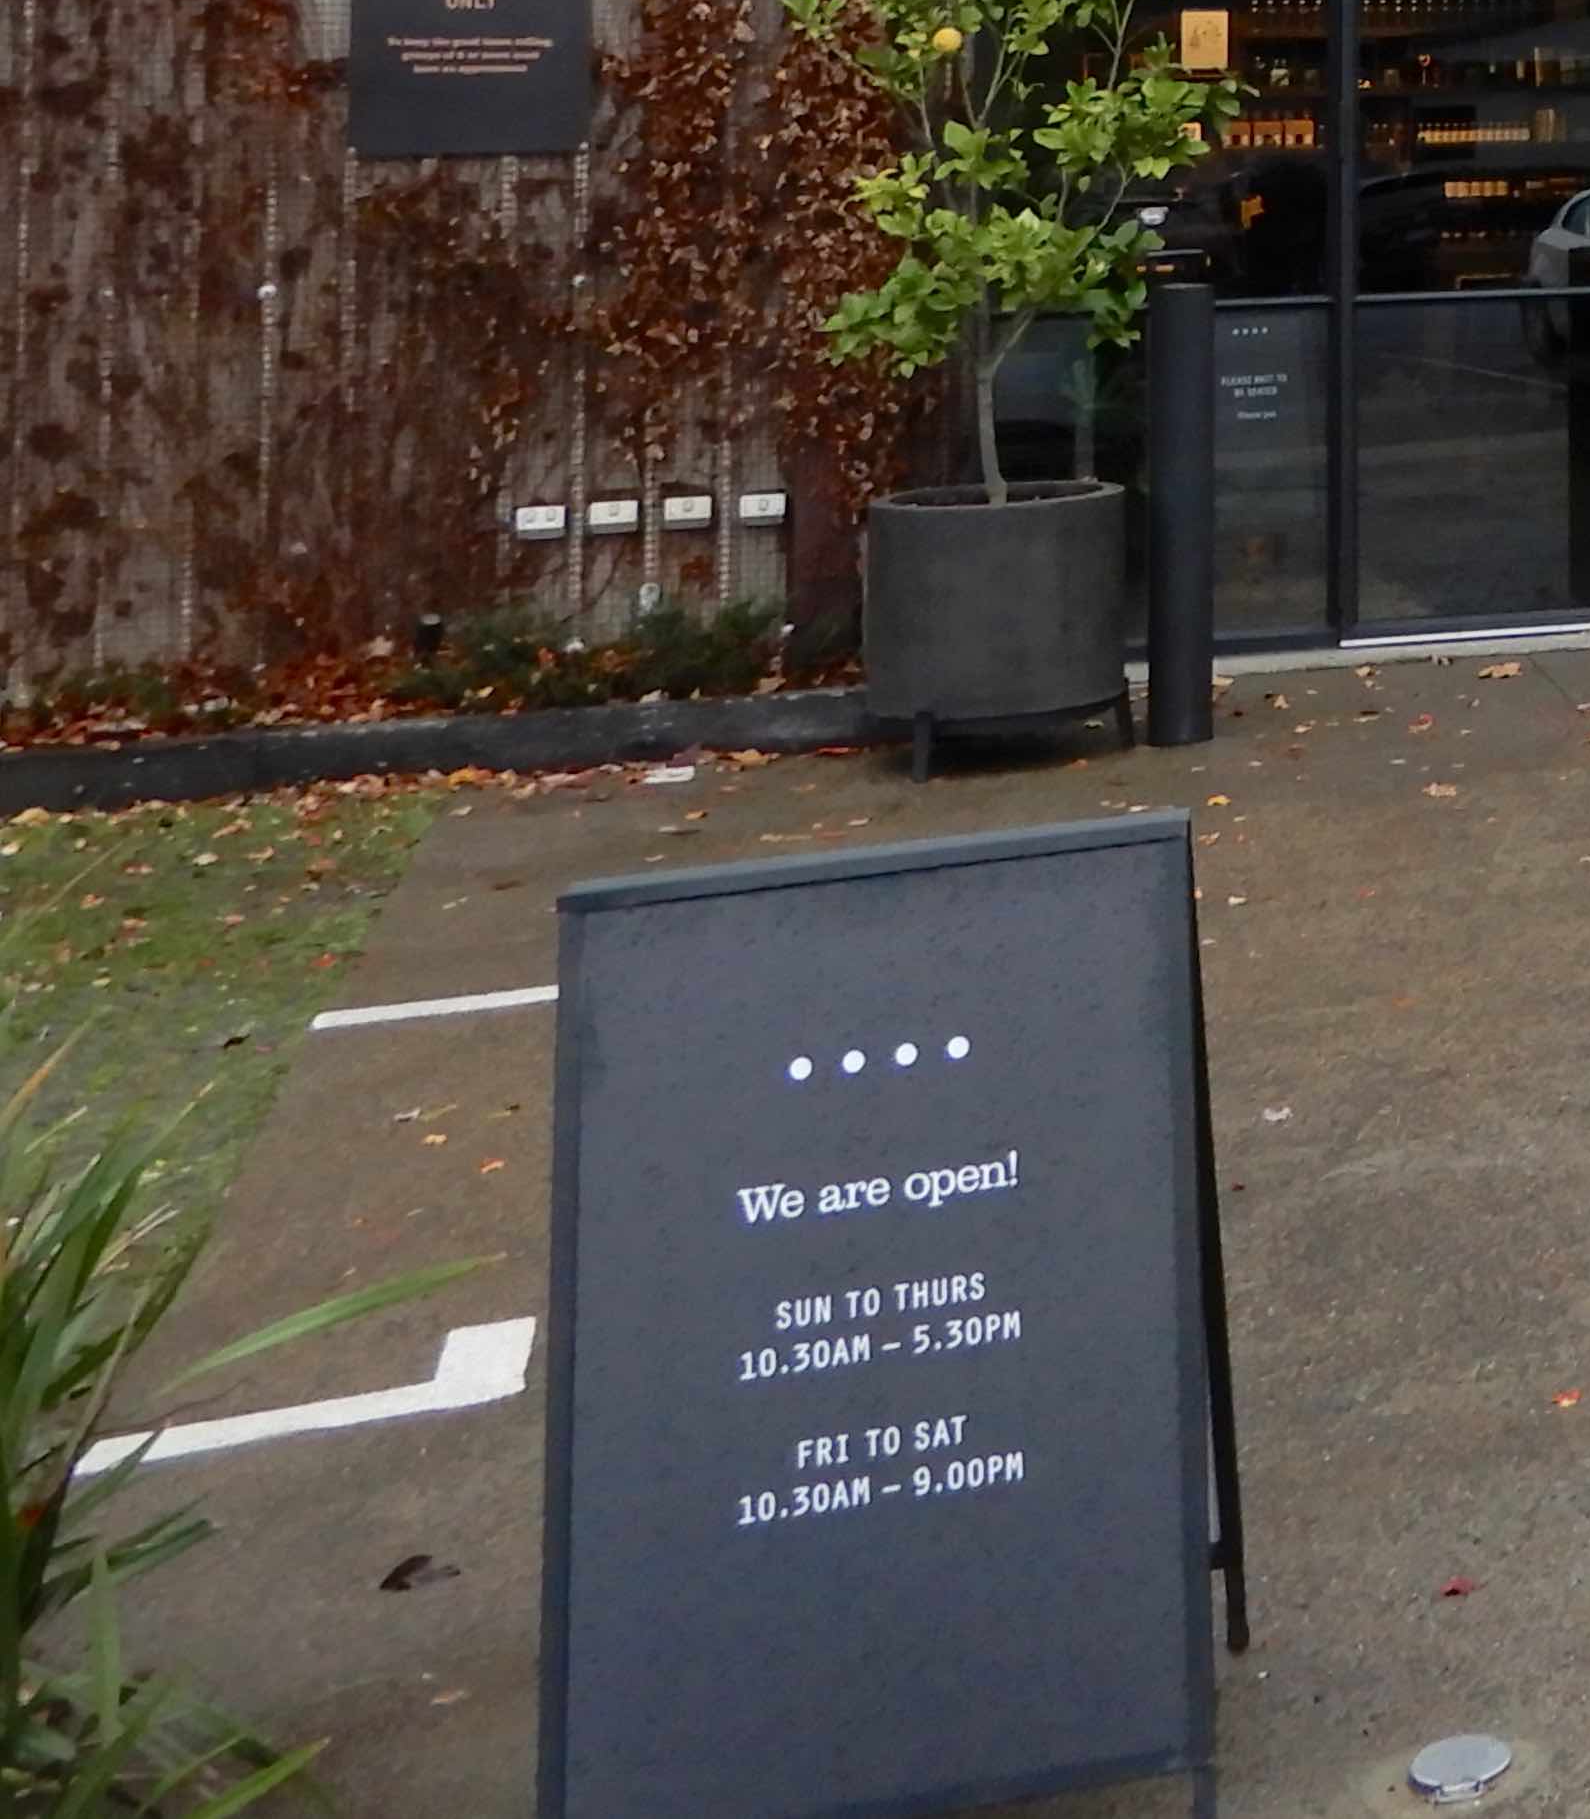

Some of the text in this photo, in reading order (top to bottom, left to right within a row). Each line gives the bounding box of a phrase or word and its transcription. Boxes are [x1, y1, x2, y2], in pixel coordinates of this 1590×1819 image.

[737, 1150, 1020, 1224] We are open!
[775, 1270, 985, 1330] SUN TO THURS
[738, 1334, 871, 1381] 10.30AM
[913, 1311, 1021, 1355] 5.30PM
[797, 1415, 967, 1469] FRI TO SAT
[737, 1476, 871, 1525] 10.30AM
[913, 1452, 1024, 1496] 9.00PM
